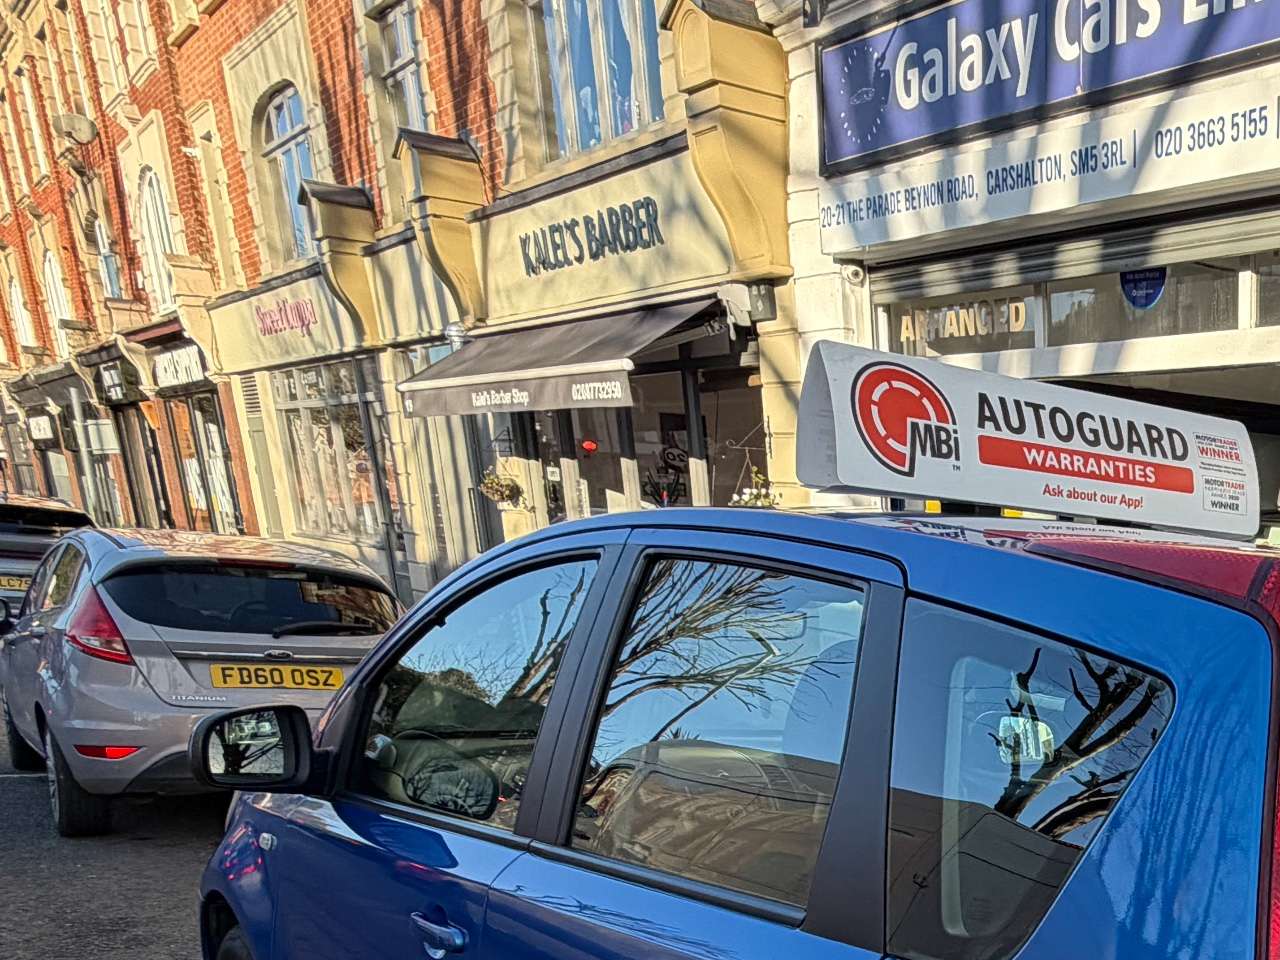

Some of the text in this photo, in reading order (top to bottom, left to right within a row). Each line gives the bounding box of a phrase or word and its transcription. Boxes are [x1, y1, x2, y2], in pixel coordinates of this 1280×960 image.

[895, 12, 1039, 111] Galaxy
[821, 203, 846, 229] 20-21
[847, 200, 864, 224] THE
[866, 190, 901, 219] PARADE
[904, 181, 944, 212] BEYNON
[1070, 145, 1099, 176] SM5
[1101, 137, 1127, 169] 3RL
[1154, 126, 1182, 159] 020
[1187, 115, 1226, 152] 3663
[1231, 106, 1268, 142] 5155
[582, 196, 664, 262] BARBER
[909, 420, 960, 463] MBi
[977, 391, 1189, 462] AUTOGUARD
[1023, 447, 1156, 484] WARRANTIES
[1198, 446, 1241, 461] WINNER
[1043, 484, 1144, 510] Ask about our App!
[1211, 500, 1240, 512] WINNER
[221, 667, 336, 687] FD60 OSZ
